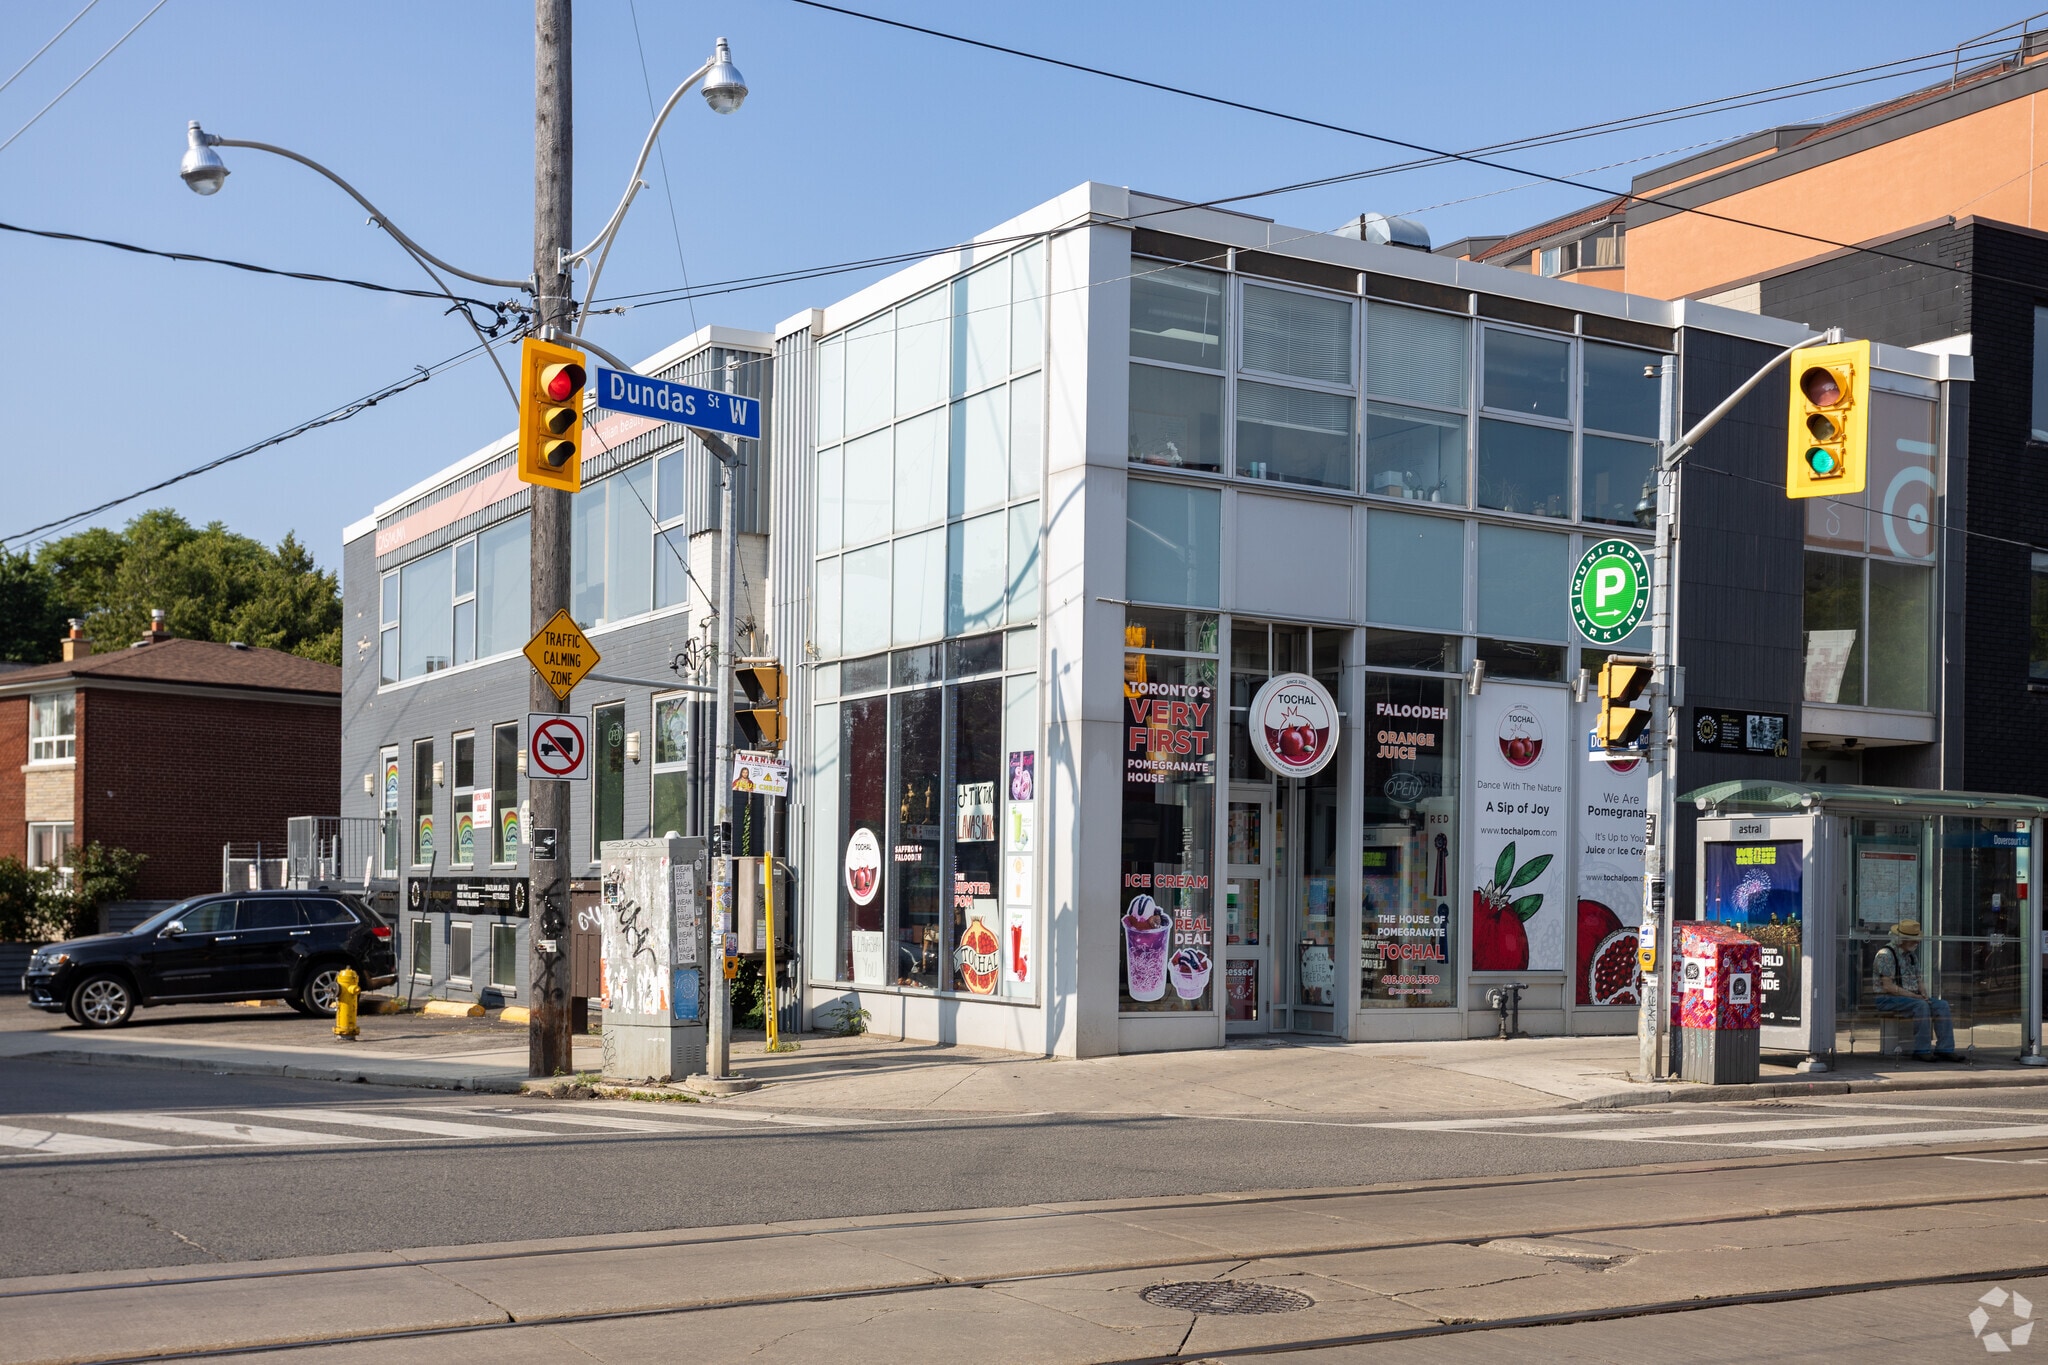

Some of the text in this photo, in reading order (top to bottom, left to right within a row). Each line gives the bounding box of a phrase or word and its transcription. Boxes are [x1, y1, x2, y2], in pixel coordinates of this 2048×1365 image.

[611, 373, 748, 426] Dundas St W
[620, 417, 644, 433] beauty
[1574, 544, 1646, 591] MUNICIPAL
[1596, 567, 1626, 608] P
[1574, 599, 1645, 640] PARKING
[545, 631, 581, 648] TRAFFIC
[543, 650, 581, 668] CALMING
[550, 671, 573, 686] ZONE
[1129, 681, 1211, 699] TORONTO'S
[1278, 694, 1316, 705] TOCHAL
[1129, 698, 1210, 727] VERY
[1376, 703, 1449, 720] FALOODEH
[1508, 715, 1535, 724] TOCHAL
[1129, 727, 1209, 755] FIRST
[1377, 730, 1435, 747] ORANGE
[1377, 745, 1416, 760] JUICE
[1127, 759, 1208, 772] POMEGRANATE
[1127, 772, 1165, 783] HOUSE
[1386, 781, 1419, 796] OPEN
[1477, 780, 1562, 793] Dance With The Nature
[1603, 792, 1640, 805] We Are
[1486, 801, 1550, 817] A Sip of Joy
[1430, 814, 1449, 824] RED
[1480, 827, 1558, 838] www.tochalpom.com
[1739, 824, 1762, 834] astral
[1595, 833, 1606, 841] It's
[1608, 833, 1619, 842] Up
[1620, 834, 1628, 842] to
[1993, 834, 2021, 846] Dovercourt
[1585, 845, 1606, 855] Juice
[1617, 846, 1629, 855] Ice
[1125, 873, 1209, 889] ICE CREAM
[954, 881, 991, 895] HIPSTER
[954, 895, 974, 907] POM
[1174, 909, 1192, 917] THE
[1377, 915, 1446, 924] THE HOUSE OF
[1175, 918, 1211, 931] REAL
[1377, 927, 1446, 937] POMEGRANATE
[1174, 933, 1211, 945] DEAL
[1377, 944, 1445, 960] TOCHAL
[961, 947, 998, 973] TOCHAL
[1311, 963, 1327, 973] LIFE
[1381, 974, 1440, 985] 416.900.3550
